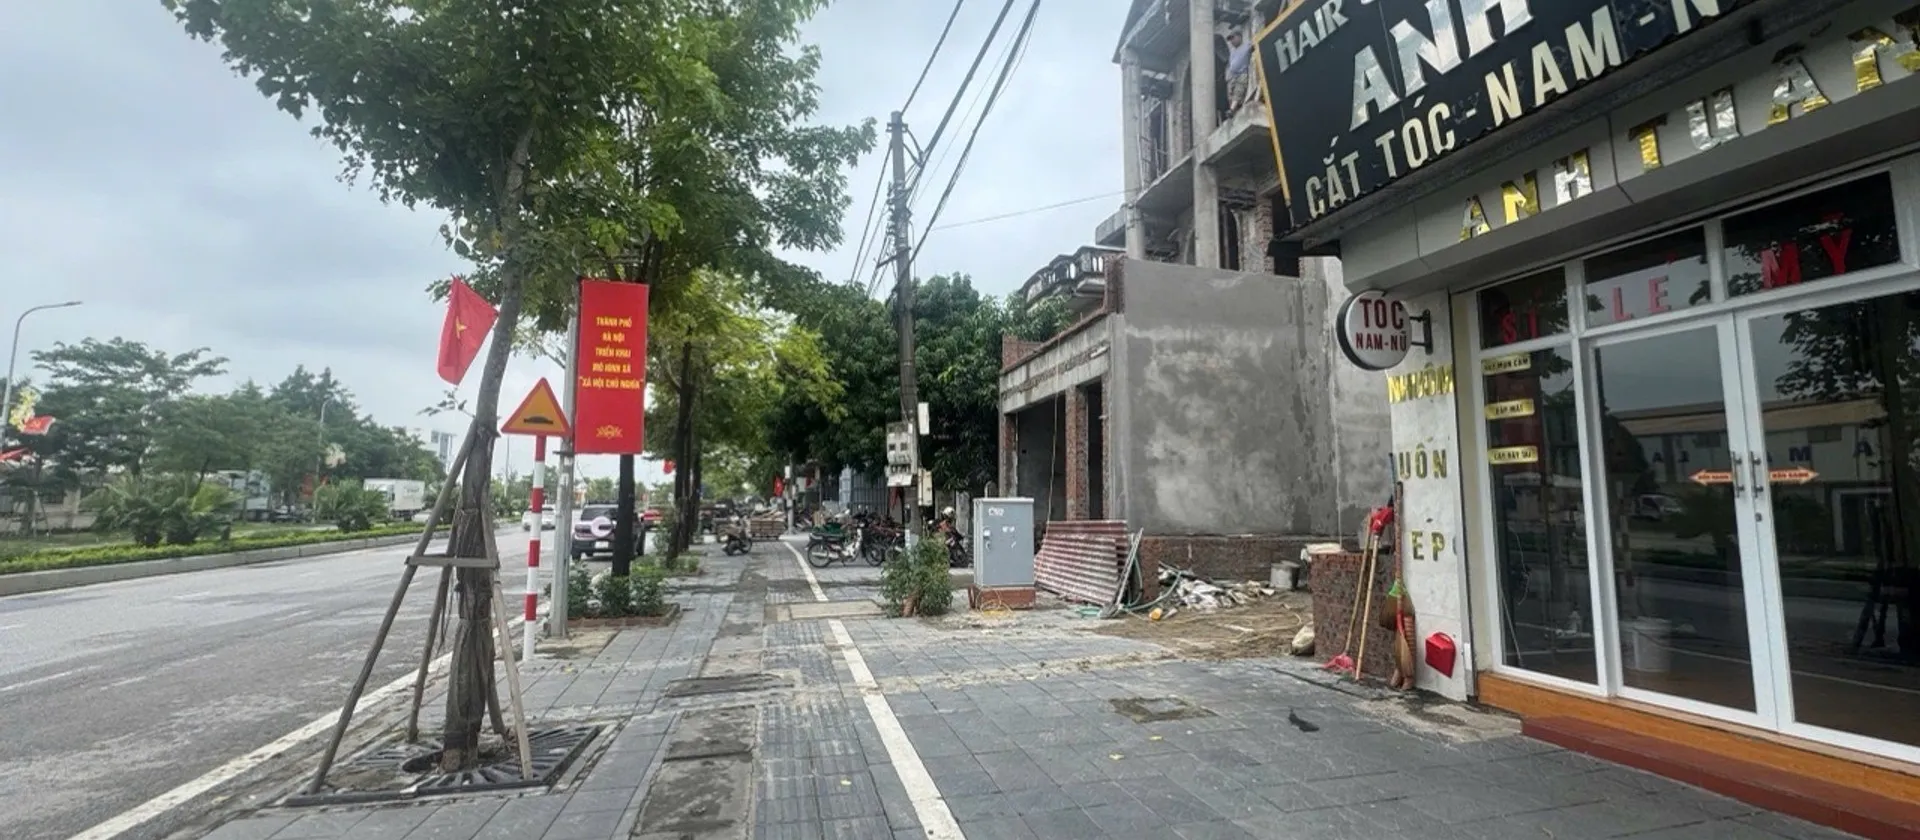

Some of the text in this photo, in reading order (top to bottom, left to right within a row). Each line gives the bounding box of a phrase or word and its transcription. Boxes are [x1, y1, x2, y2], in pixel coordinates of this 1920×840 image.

[1273, 0, 1348, 73] HAIR
[1350, 0, 1535, 132] ANH
[1306, 136, 1362, 219] CẮT
[1376, 95, 1456, 178] TÓC
[1485, 4, 1622, 127] NAM
[1459, 147, 1595, 242] ANH
